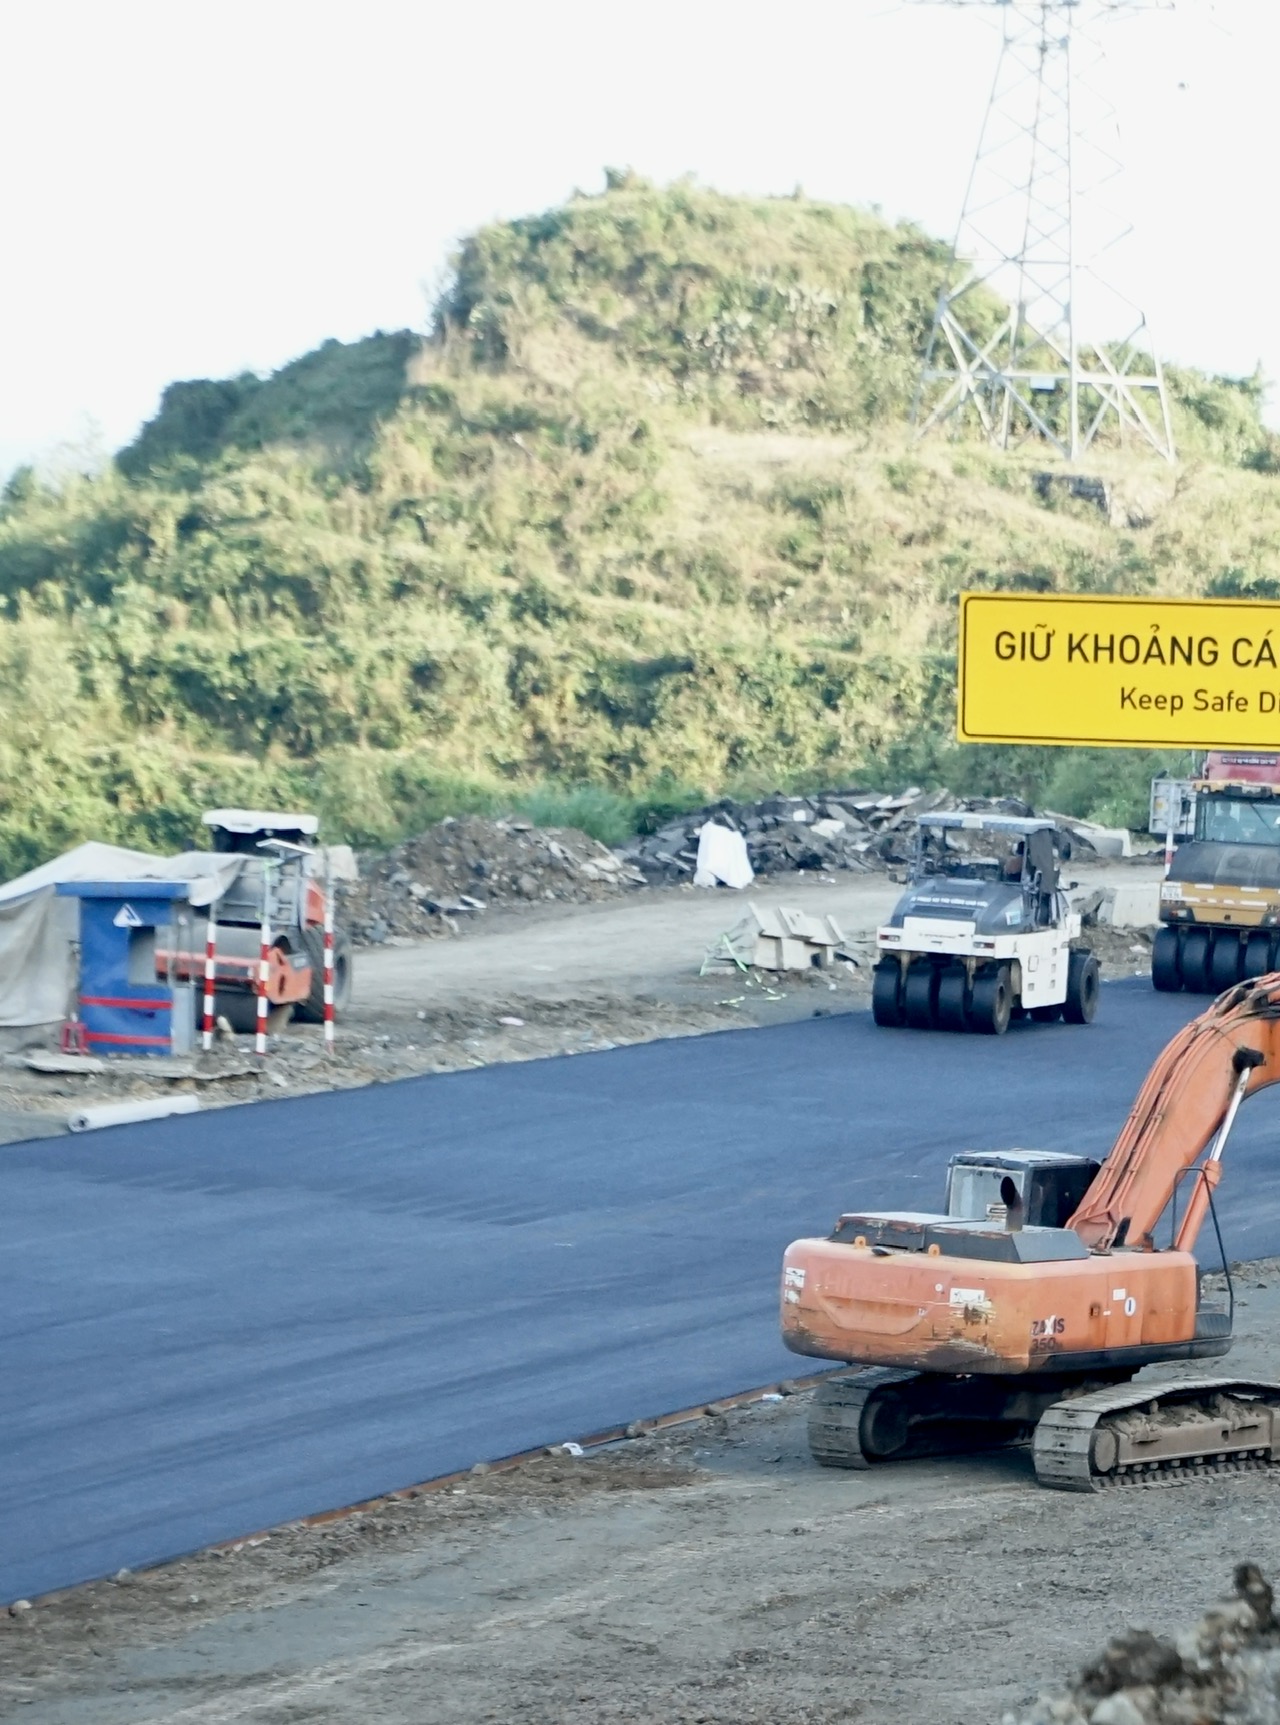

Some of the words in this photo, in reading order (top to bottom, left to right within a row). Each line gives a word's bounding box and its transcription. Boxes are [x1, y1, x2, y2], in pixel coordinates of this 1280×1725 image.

[995, 624, 1055, 662] GIỮ
[1067, 624, 1219, 667] KHOẢNG
[1121, 687, 1184, 716] Keep
[1194, 688, 1249, 713] Safe
[1032, 1315, 1065, 1336] ZAXIS
